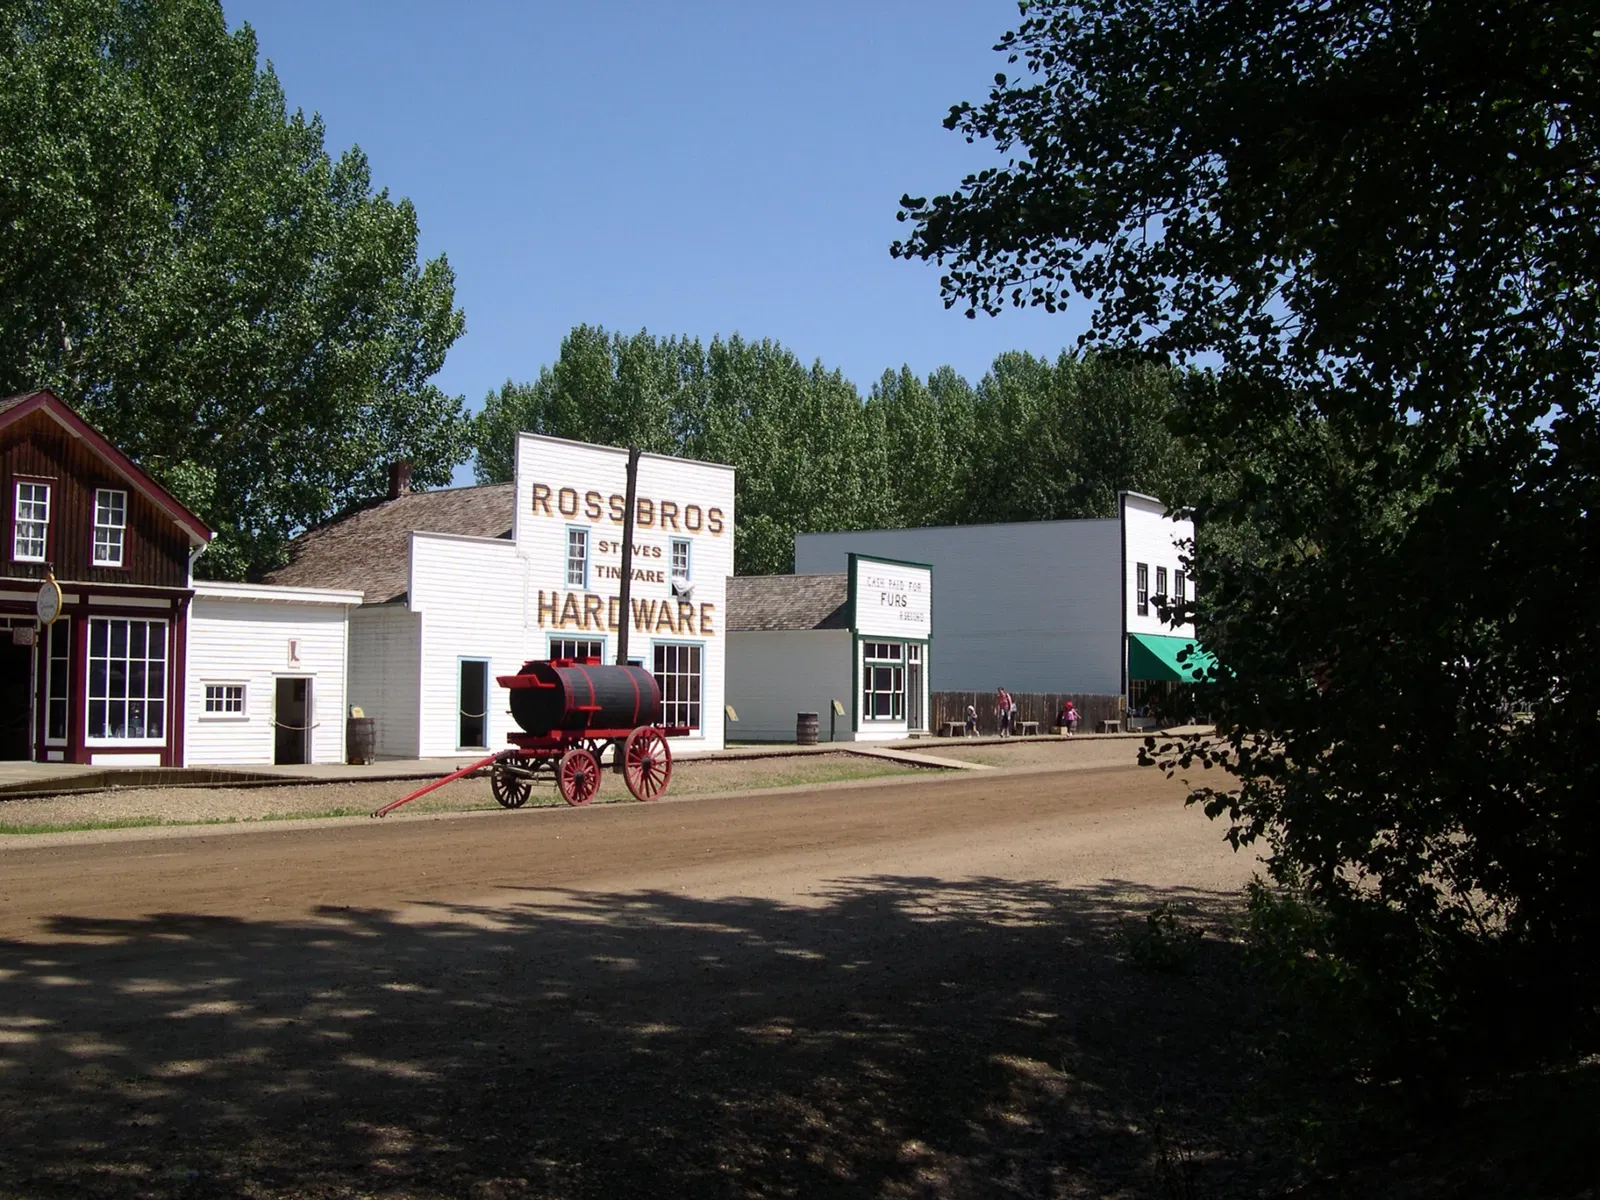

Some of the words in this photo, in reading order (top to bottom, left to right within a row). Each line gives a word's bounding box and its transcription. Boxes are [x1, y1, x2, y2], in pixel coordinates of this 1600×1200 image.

[532, 483, 625, 523] ROSS
[637, 497, 725, 537] BROS
[599, 541, 661, 558] STVES
[881, 592, 907, 607] FURS
